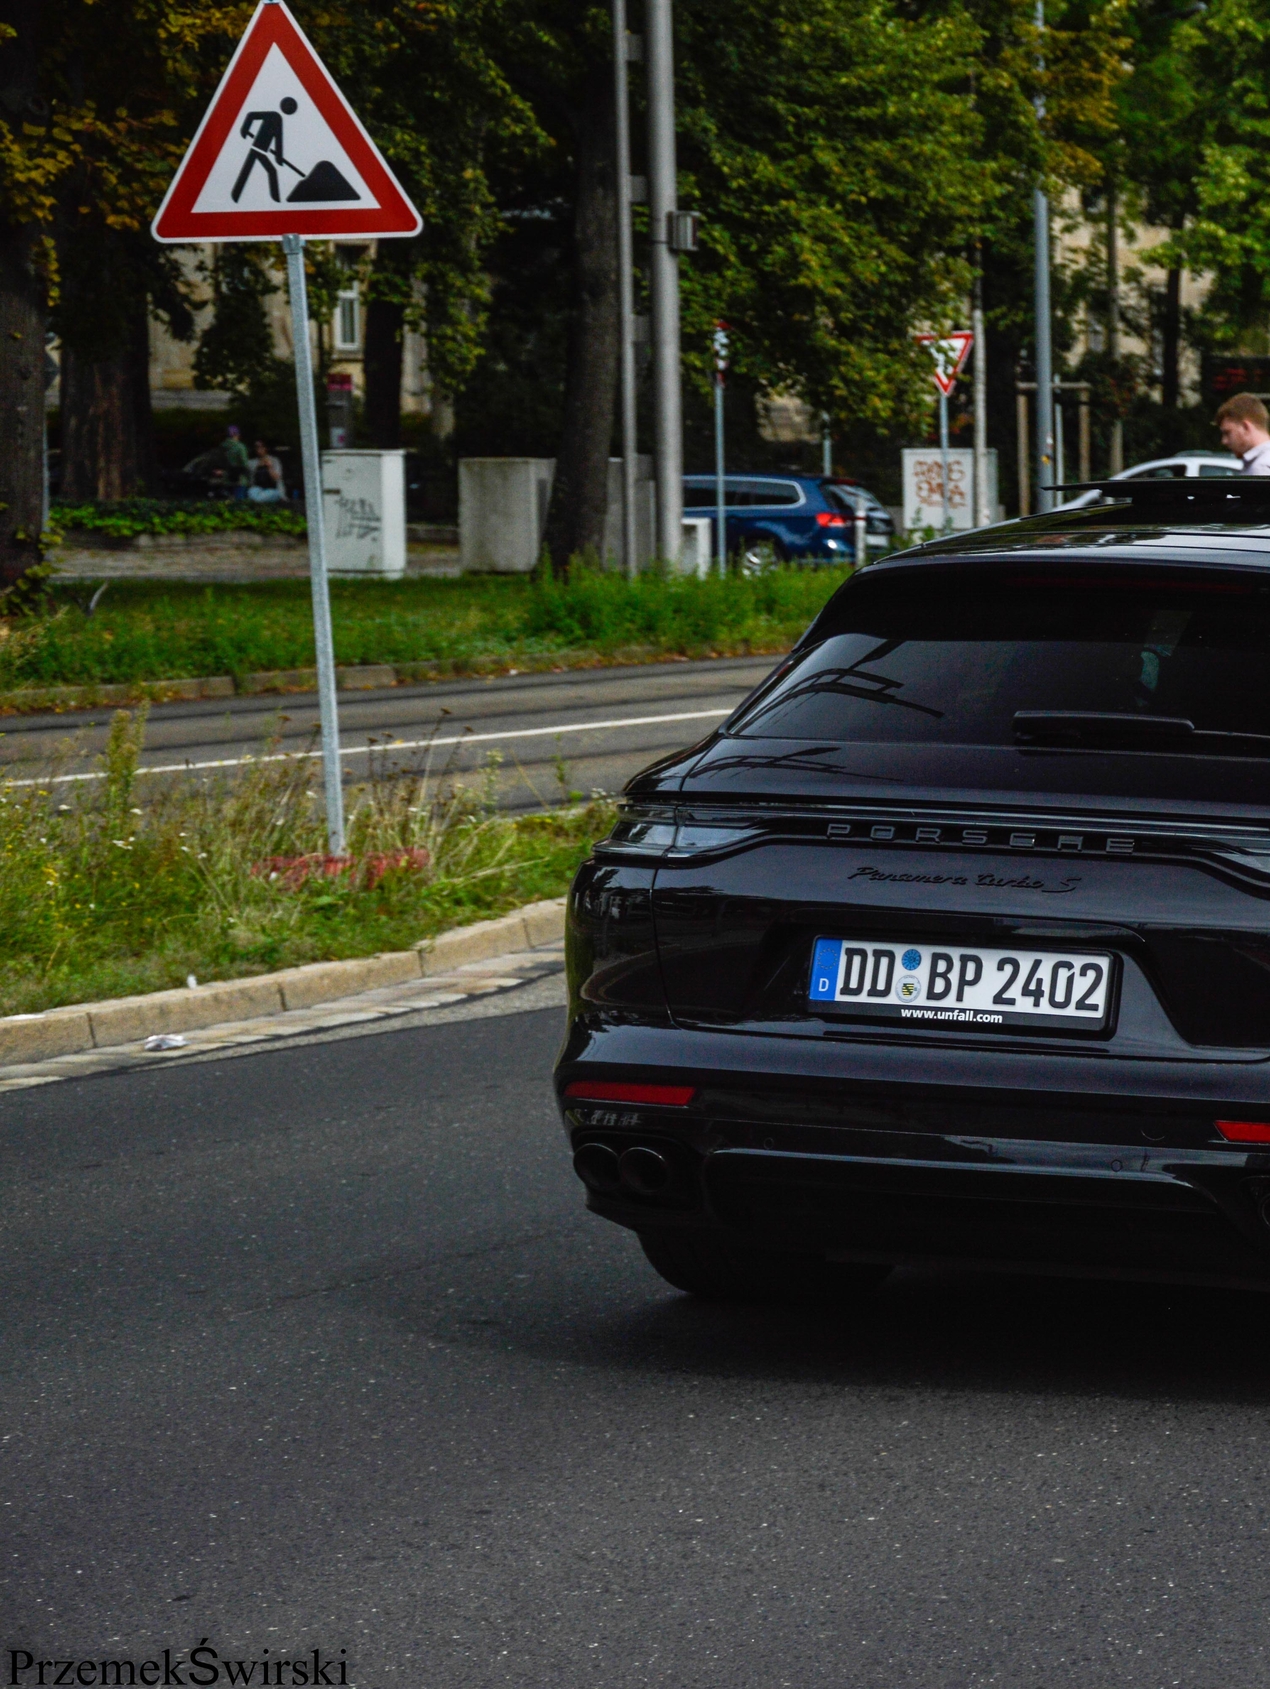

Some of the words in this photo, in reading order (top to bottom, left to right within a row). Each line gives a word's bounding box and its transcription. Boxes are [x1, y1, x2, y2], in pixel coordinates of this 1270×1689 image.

[826, 823, 1137, 854] PORSCHE
[847, 866, 968, 885] Panamera
[1041, 876, 1082, 893] S
[818, 977, 829, 992] D
[839, 947, 896, 998] DD
[926, 952, 983, 1002] BP
[992, 956, 1104, 1012] 2402
[900, 1006, 1003, 1024] www.unfall.com
